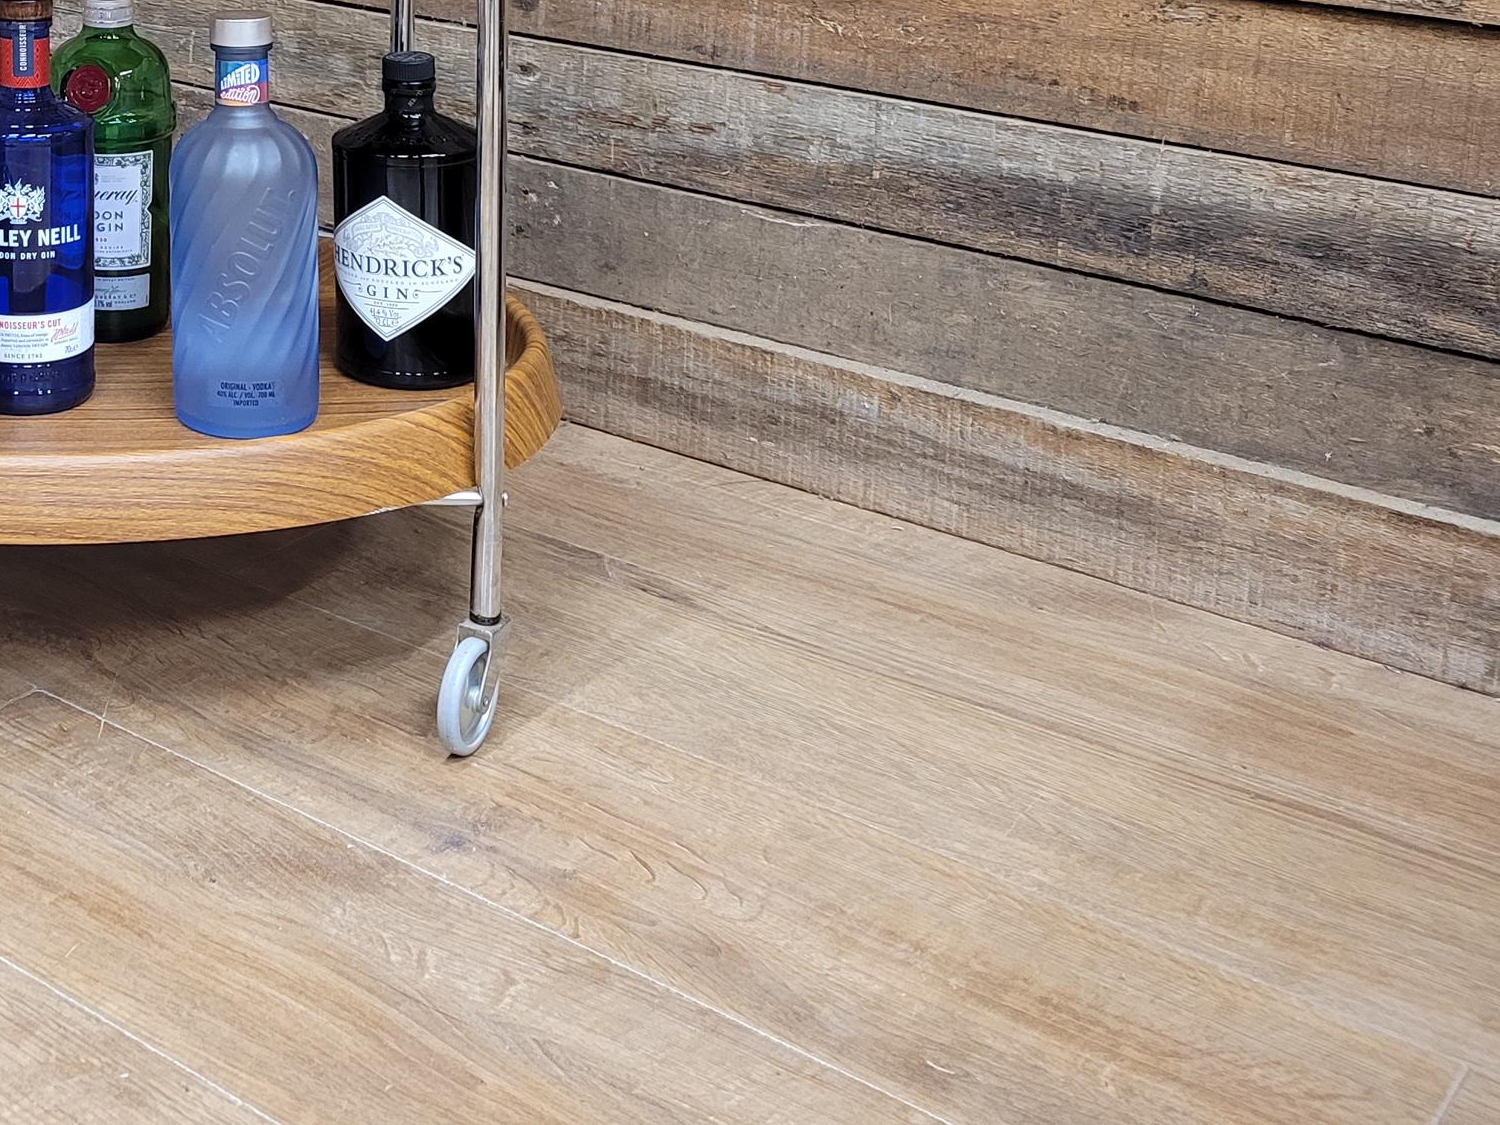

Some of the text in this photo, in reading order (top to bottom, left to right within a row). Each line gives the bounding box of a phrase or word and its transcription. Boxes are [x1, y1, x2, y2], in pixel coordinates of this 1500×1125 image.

[38, 224, 81, 246] NEILL
[20, 252, 37, 260] DRY
[41, 251, 56, 259] GIN
[198, 187, 297, 343] ABSOLUT
[366, 284, 409, 300] GIN
[47, 318, 62, 328] CUT
[220, 381, 273, 391] ORIGINAL VODKA
